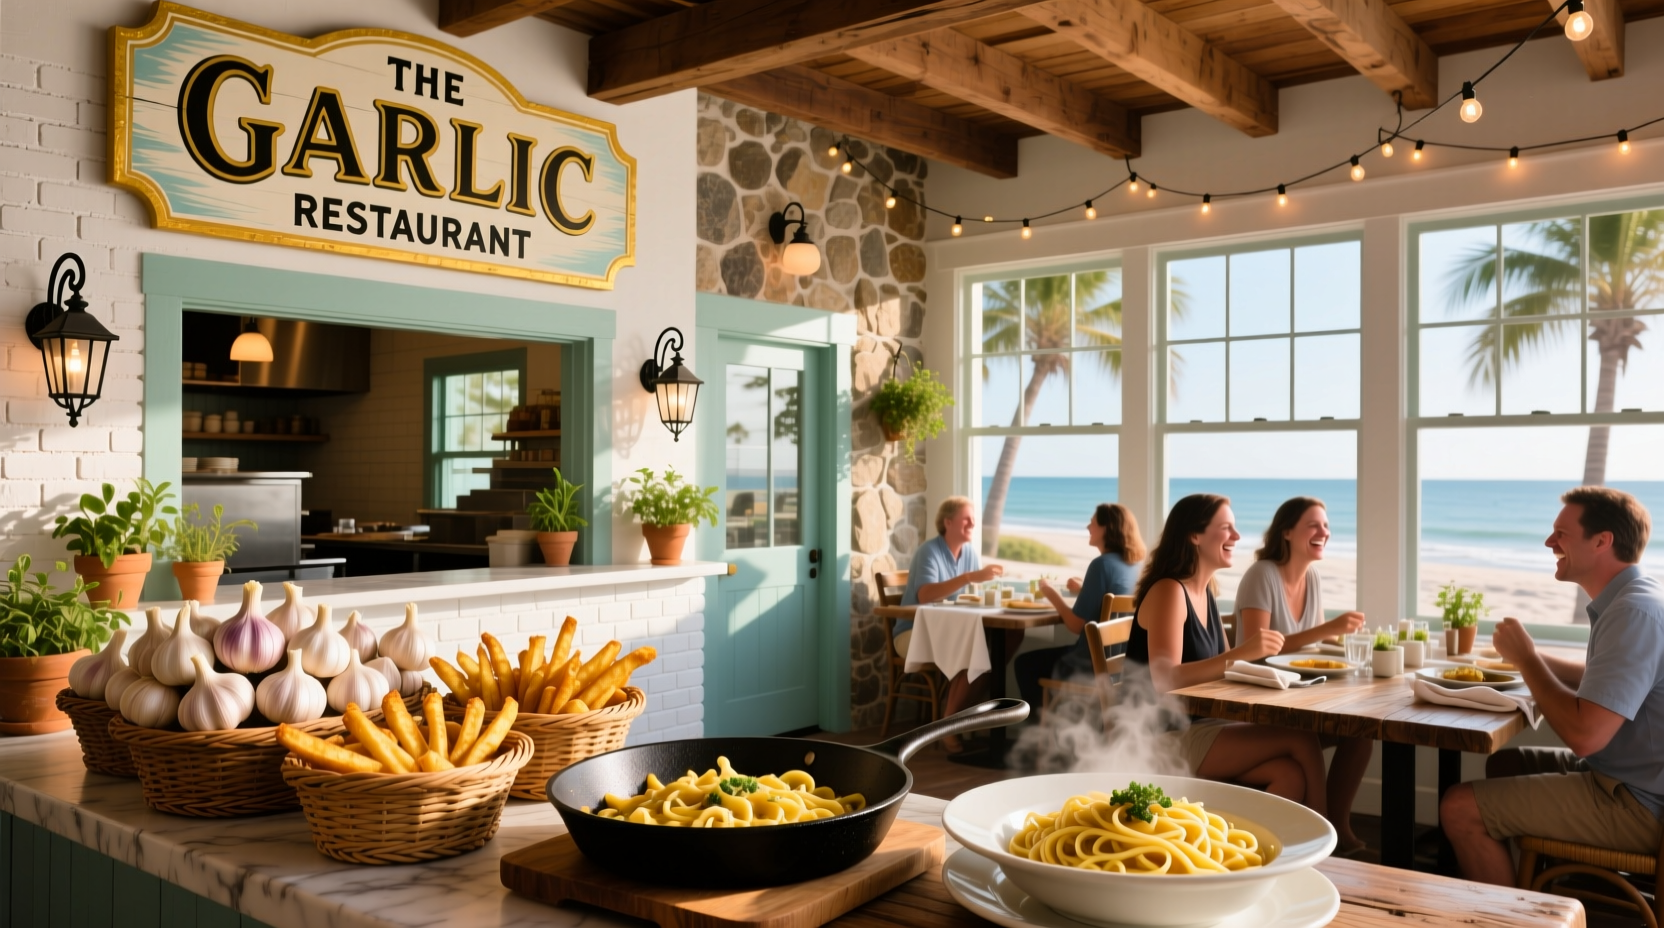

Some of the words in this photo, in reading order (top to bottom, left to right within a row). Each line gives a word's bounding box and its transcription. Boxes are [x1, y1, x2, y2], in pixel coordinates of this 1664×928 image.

[387, 56, 464, 107] THE
[177, 54, 596, 236] GARLIC
[293, 193, 532, 260] RESTAURANT
